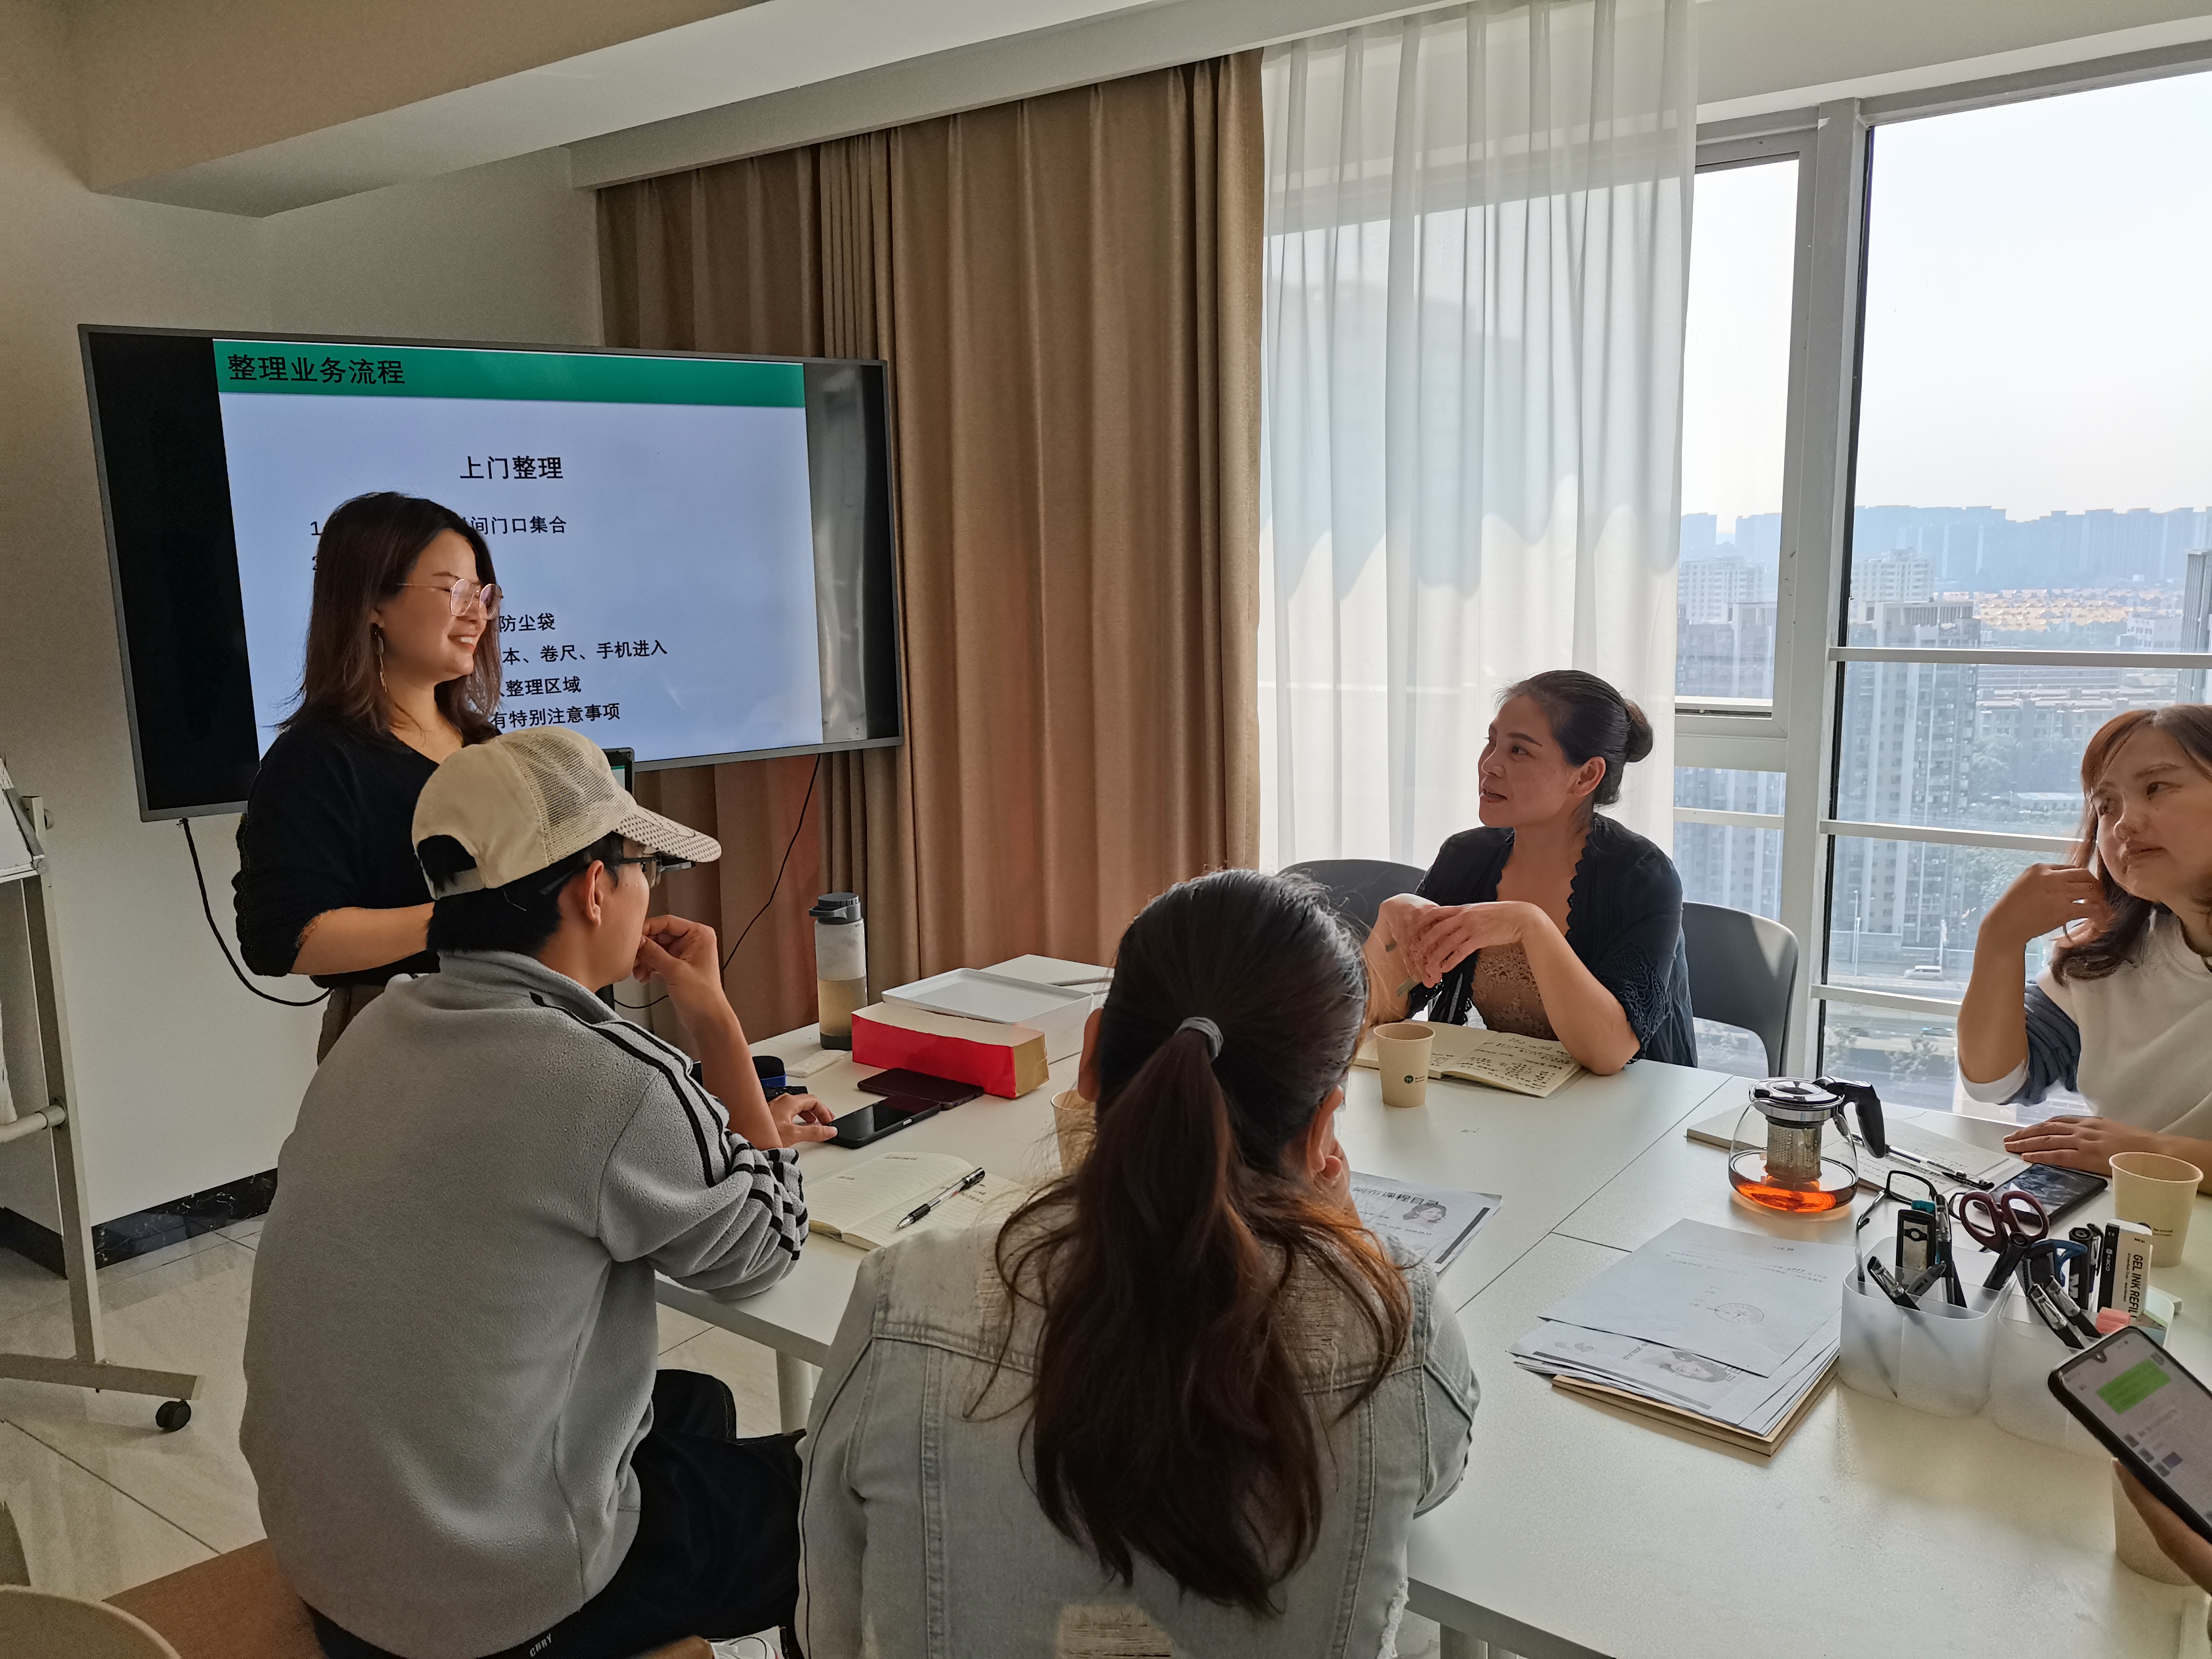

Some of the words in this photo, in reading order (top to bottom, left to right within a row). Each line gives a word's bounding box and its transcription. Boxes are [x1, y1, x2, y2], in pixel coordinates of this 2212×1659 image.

[228, 354, 405, 384] 整理业务流程
[460, 456, 563, 479] 上门整理
[463, 516, 566, 535] 间门口集合
[499, 613, 555, 632] 防尘袋
[500, 676, 581, 697] 整理区域
[491, 703, 620, 729] 有特别注意事项
[2132, 1254, 2143, 1271] GEL
[2130, 1273, 2142, 1290] INK
